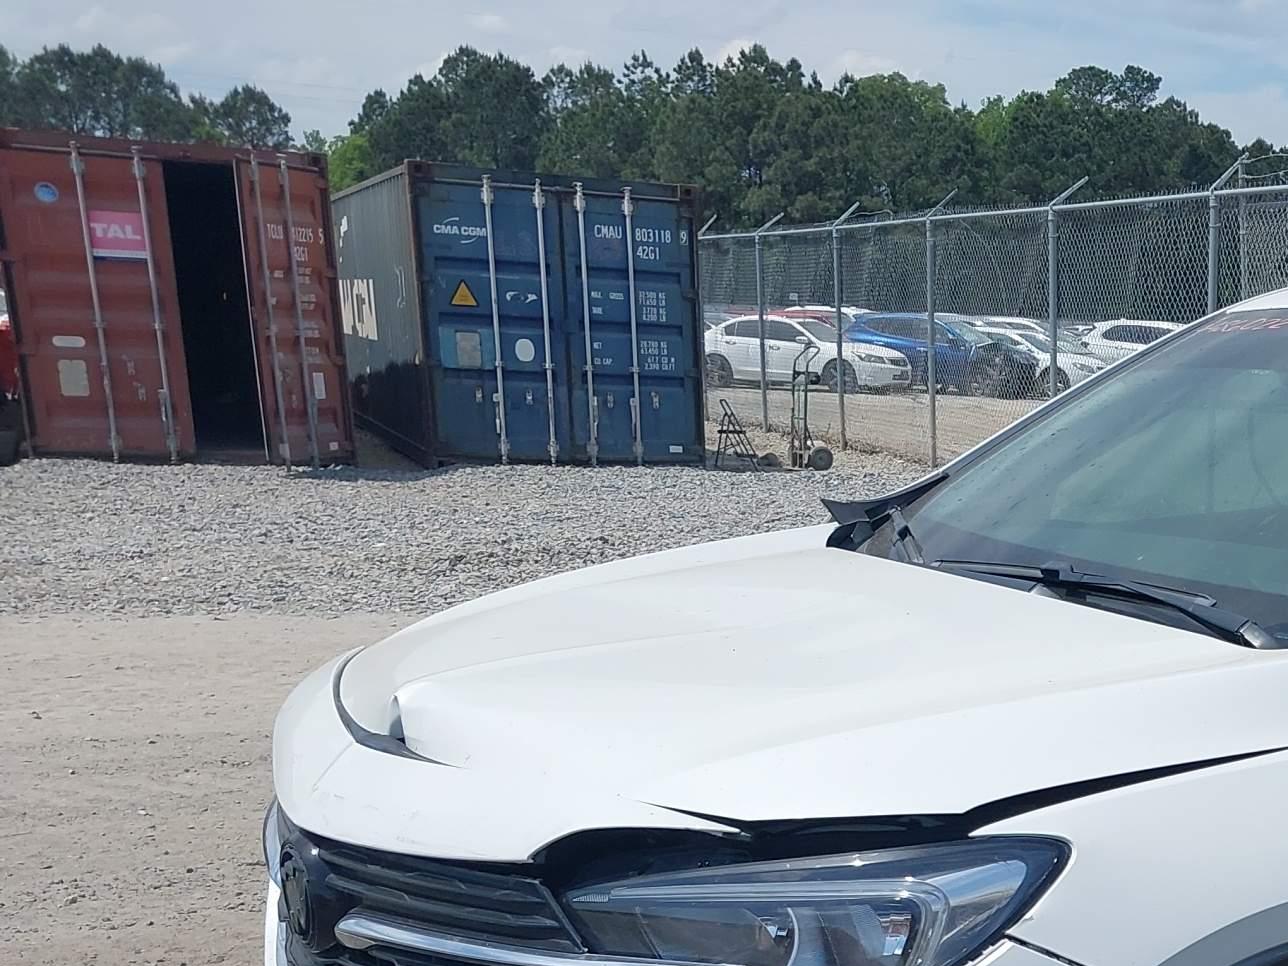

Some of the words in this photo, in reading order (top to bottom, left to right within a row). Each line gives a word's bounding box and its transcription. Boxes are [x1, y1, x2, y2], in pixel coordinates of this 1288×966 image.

[90, 222, 142, 240] TAL
[318, 227, 325, 244] 5
[433, 224, 459, 235] CMA
[461, 226, 487, 237] CGM
[594, 224, 622, 239] CMAU
[635, 228, 671, 243] 803118
[680, 230, 688, 245] 9
[636, 246, 660, 260] 42G1
